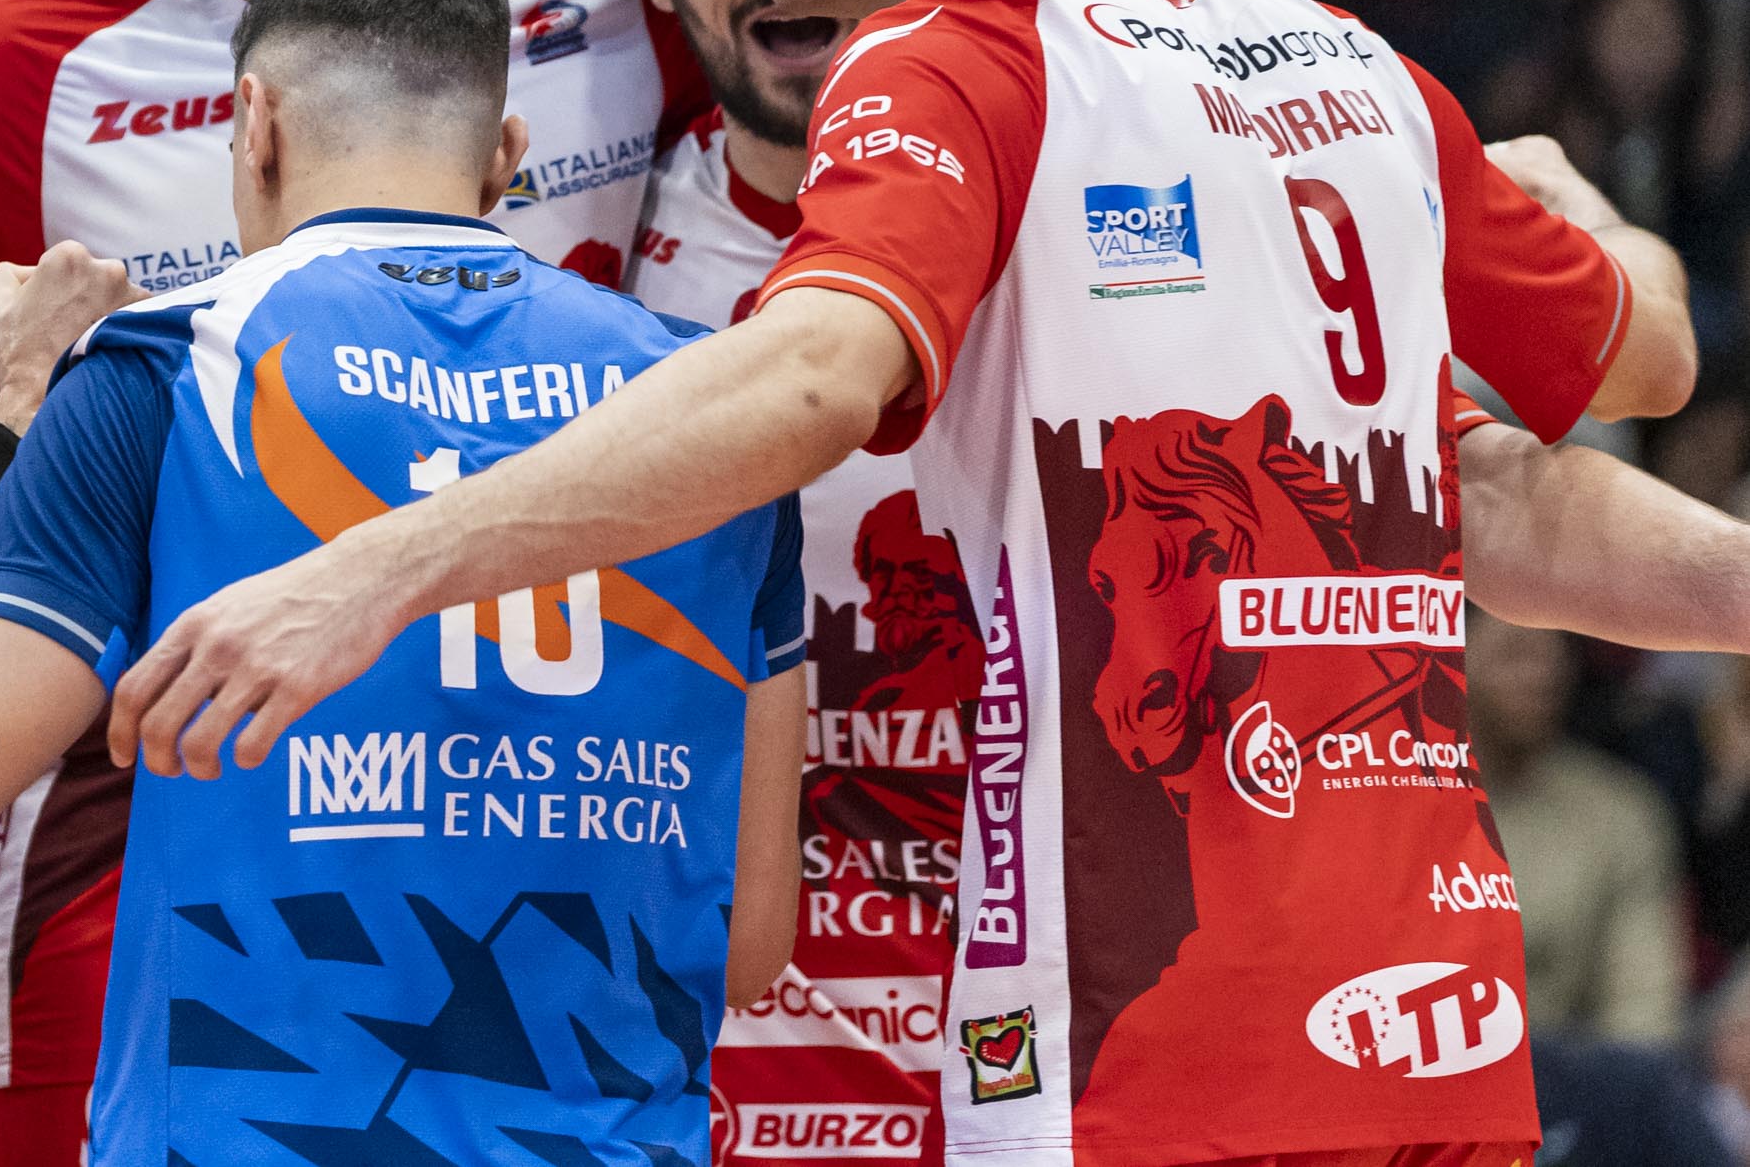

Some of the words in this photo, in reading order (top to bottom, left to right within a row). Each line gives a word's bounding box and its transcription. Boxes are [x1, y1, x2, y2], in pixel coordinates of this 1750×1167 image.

[86, 91, 235, 145] Zeus
[845, 128, 965, 185] 1965
[1086, 203, 1187, 234] SPORT
[1088, 228, 1189, 256] VALLEY
[122, 240, 241, 278] ITALIA
[1284, 175, 1386, 407] 9
[438, 733, 556, 782] GAS
[575, 735, 691, 791] SALES
[1316, 730, 1385, 771] CPL
[1323, 775, 1388, 791] ENERGIA
[443, 791, 688, 848] ENERGIA
[802, 834, 961, 884] SALES
[808, 890, 953, 937] RGIA
[752, 1113, 918, 1148] BURZO
